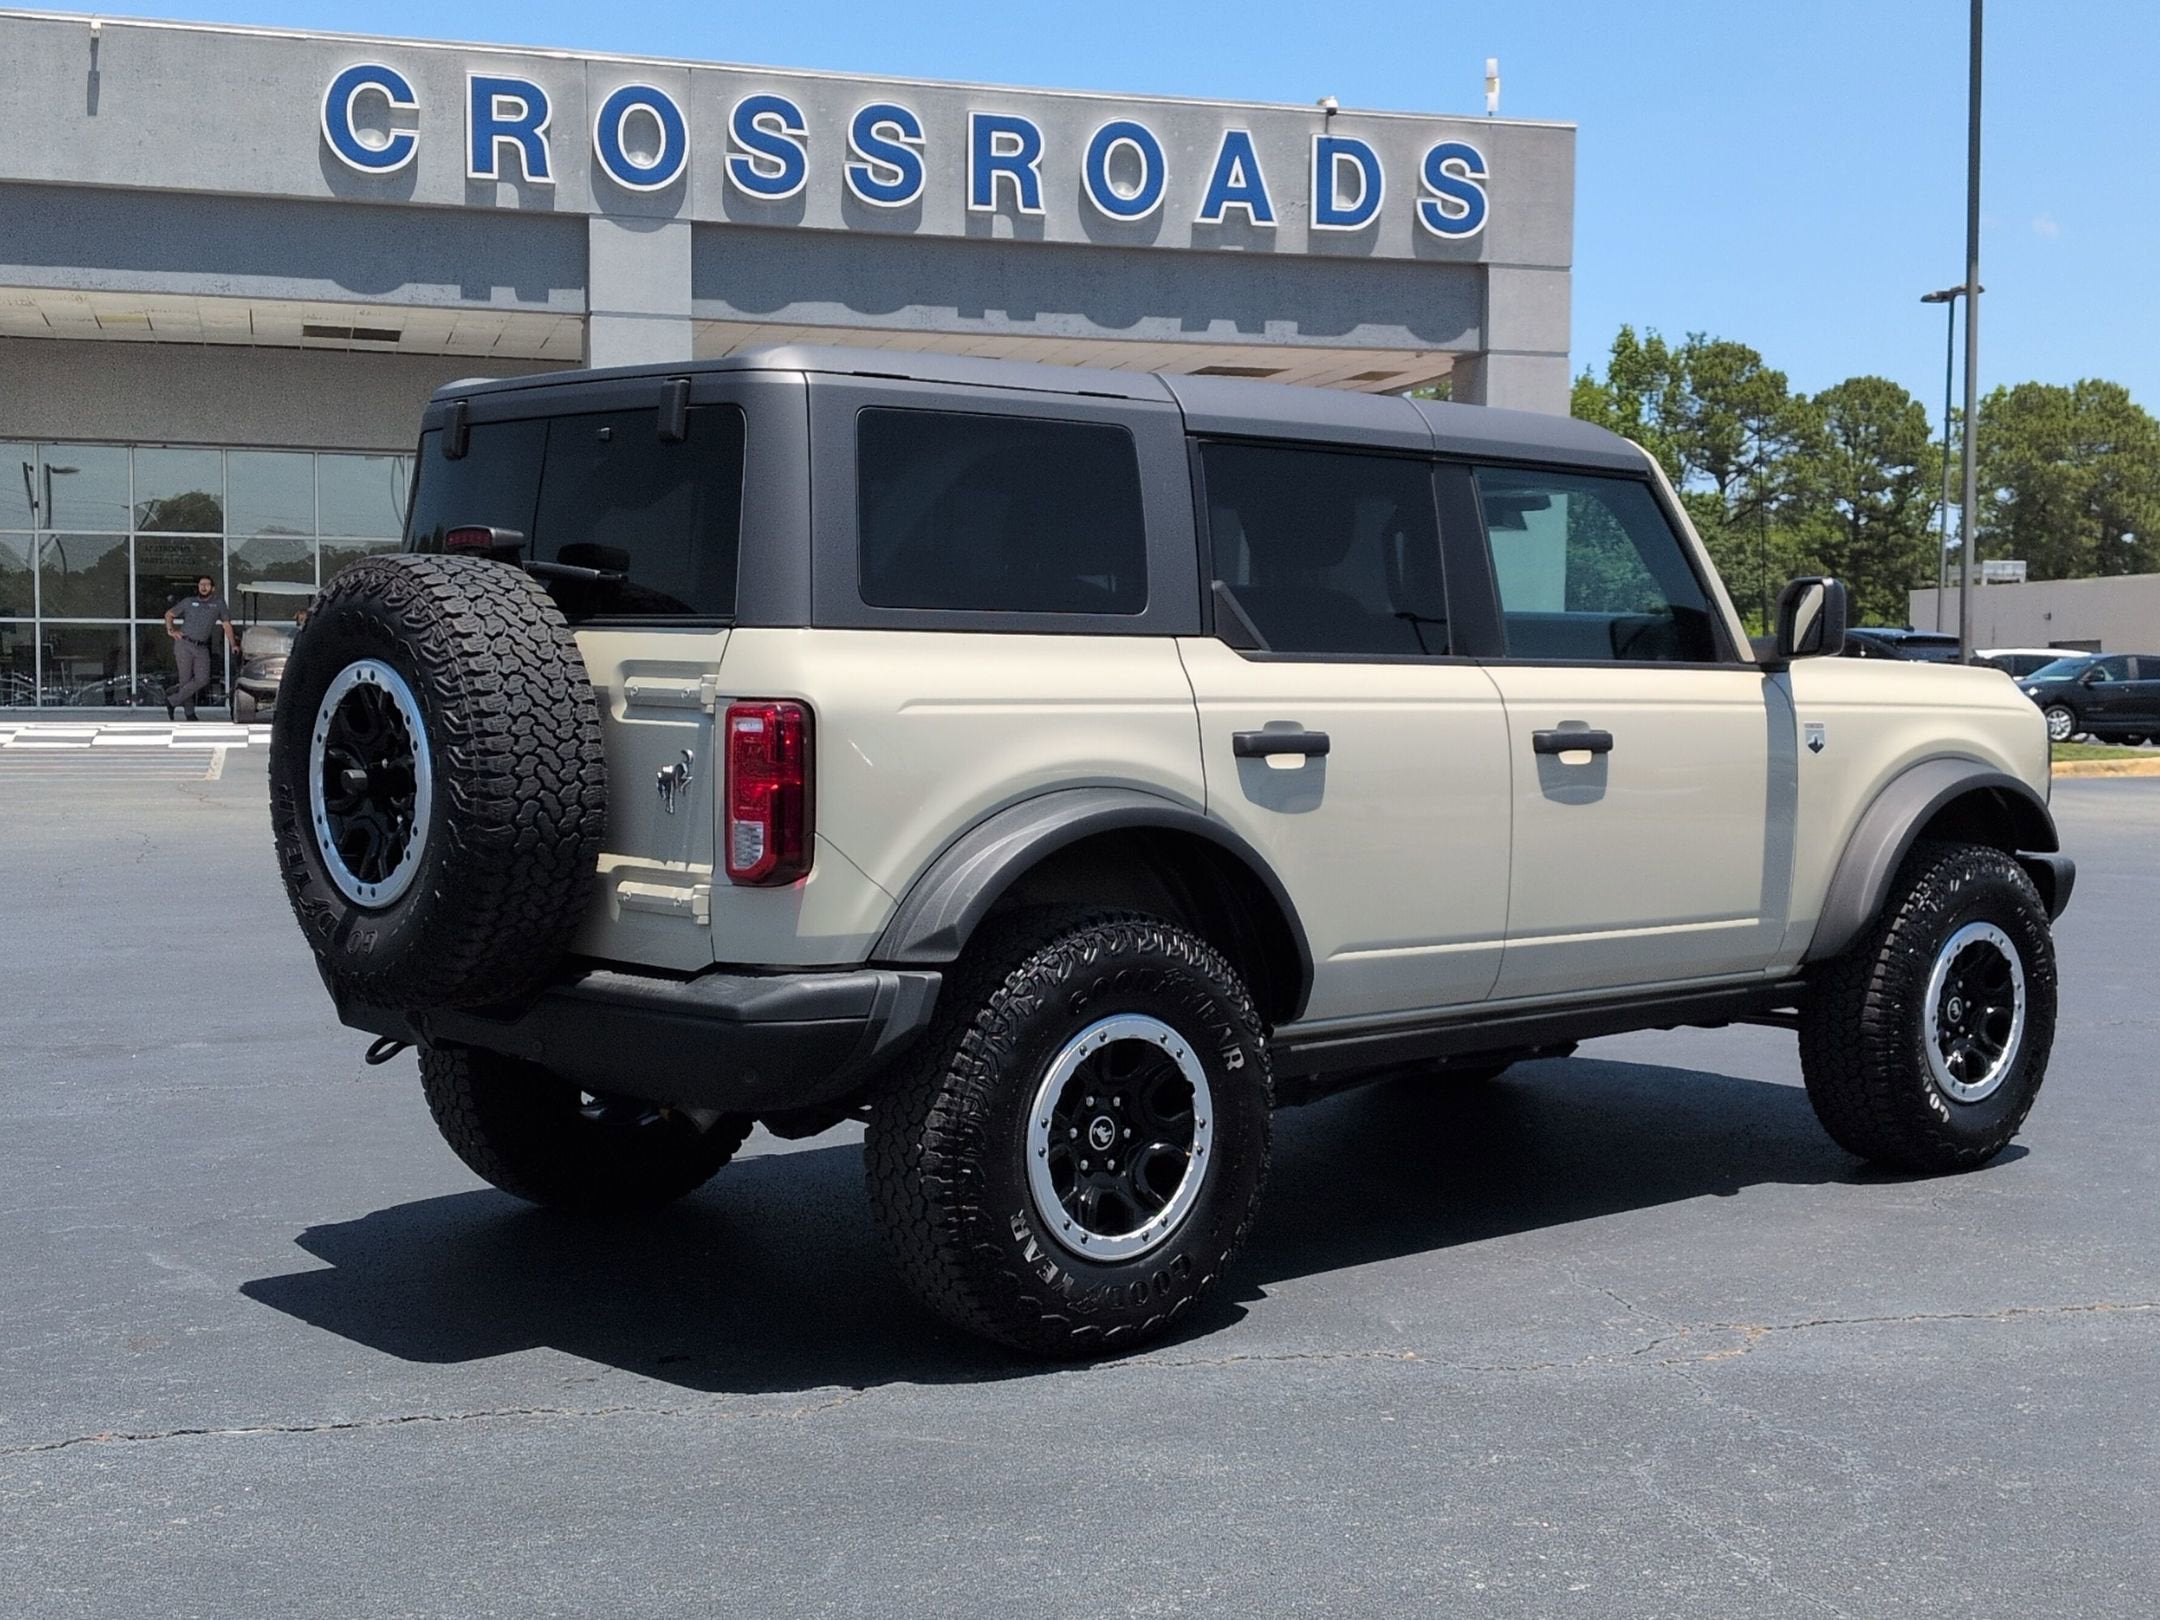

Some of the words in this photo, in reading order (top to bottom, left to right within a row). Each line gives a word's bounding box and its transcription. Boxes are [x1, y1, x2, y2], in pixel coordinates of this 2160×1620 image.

[319, 61, 1491, 240] CROSSROADS
[278, 783, 379, 956] GODYEAR
[1068, 967, 1247, 1073] GOODYEAR
[1009, 1208, 1193, 1312] GOODYEAR
